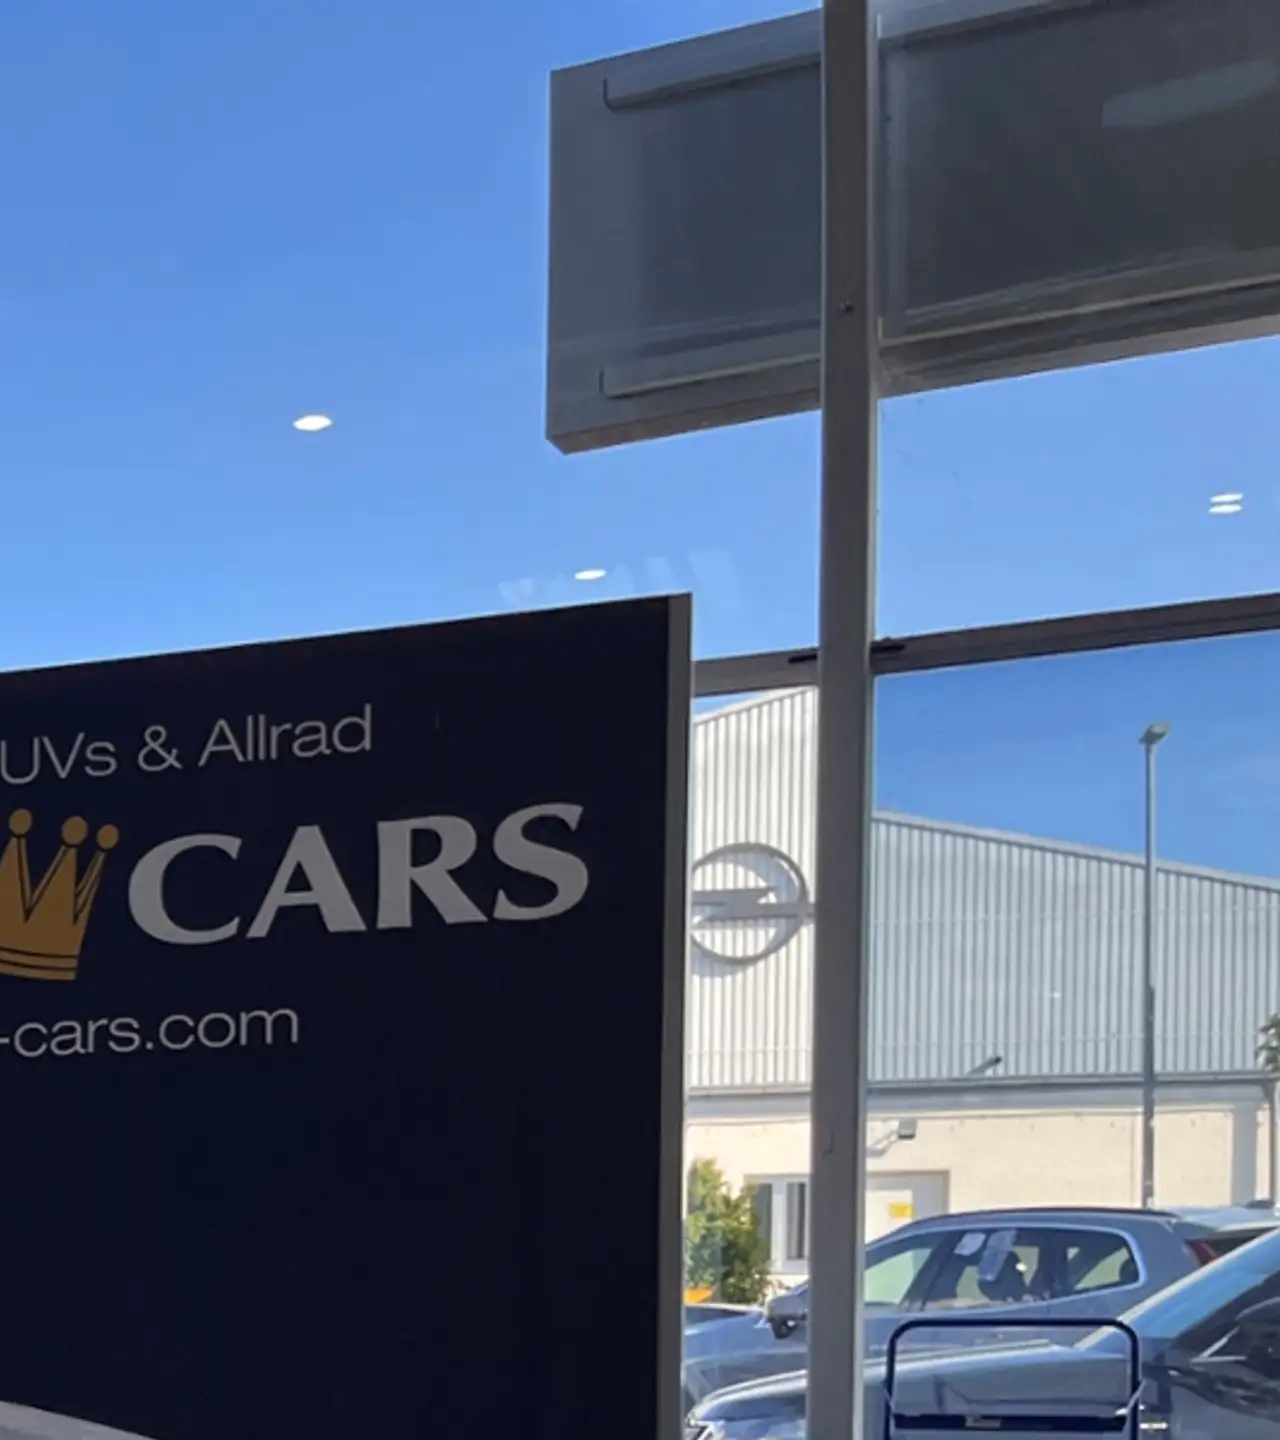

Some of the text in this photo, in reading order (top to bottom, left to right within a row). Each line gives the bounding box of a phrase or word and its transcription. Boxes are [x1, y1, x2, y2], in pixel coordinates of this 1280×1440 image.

[138, 725, 183, 773] &
[198, 703, 372, 767] Allrad
[126, 802, 590, 947] CARS
